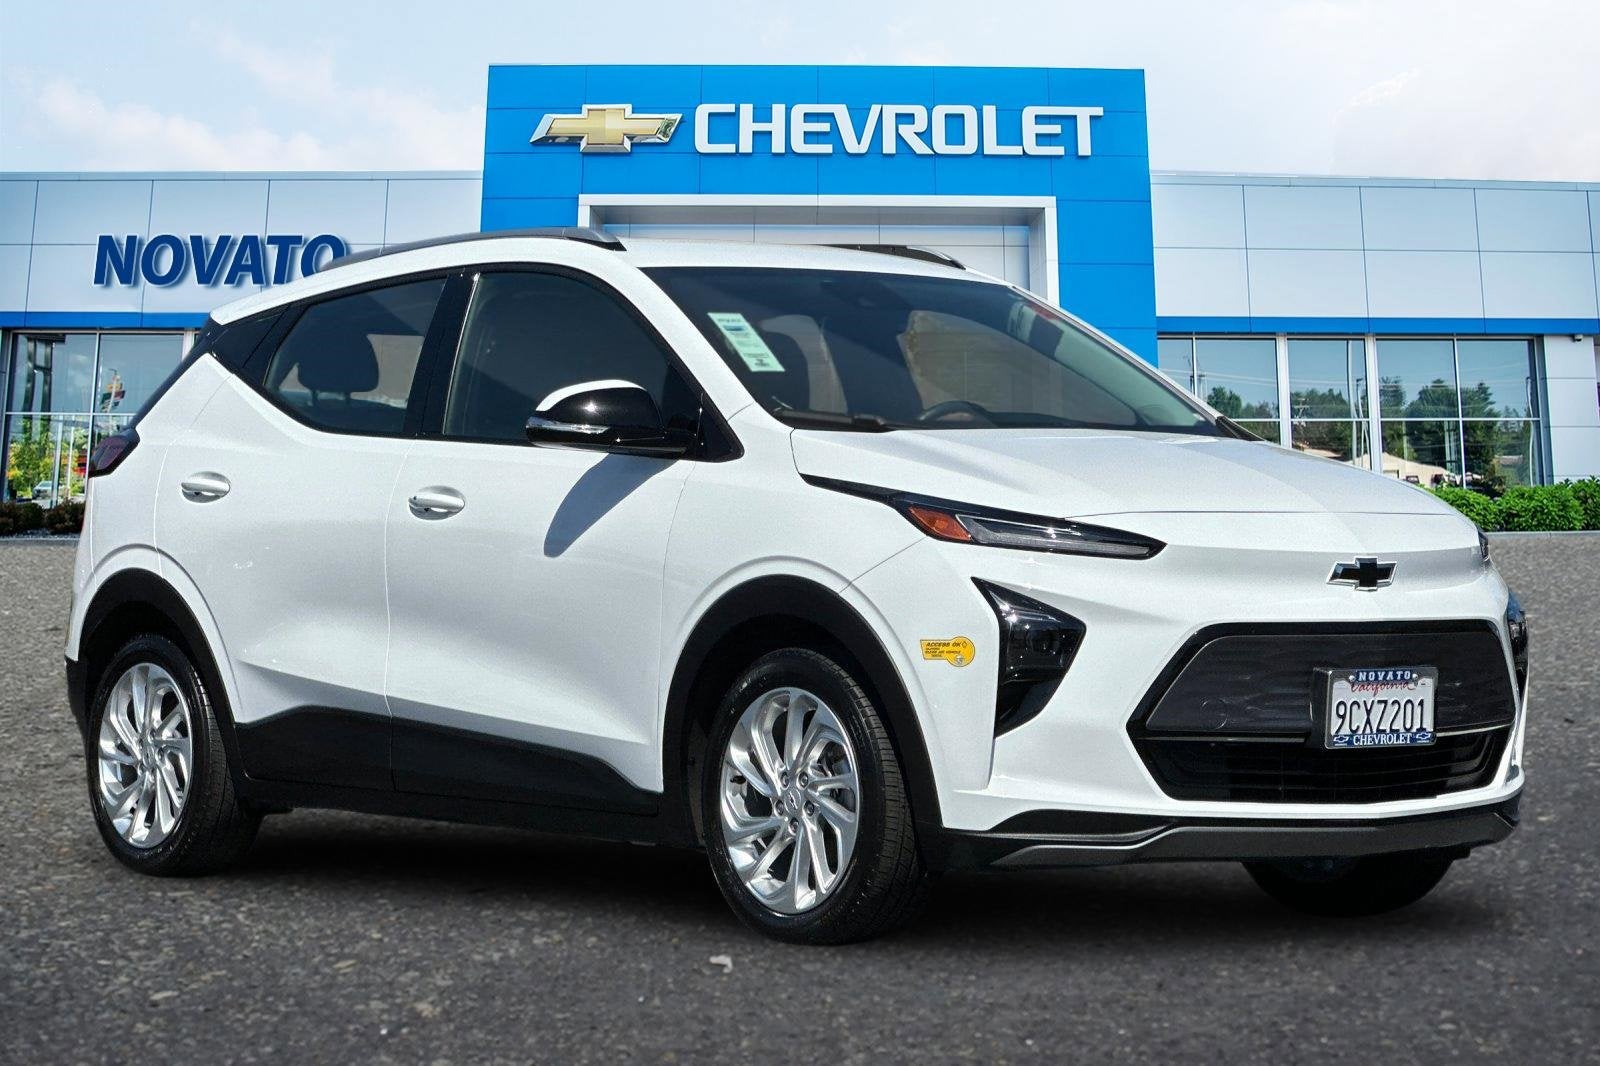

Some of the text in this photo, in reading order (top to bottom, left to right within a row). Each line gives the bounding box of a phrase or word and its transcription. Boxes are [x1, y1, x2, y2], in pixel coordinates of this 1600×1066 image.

[693, 103, 1104, 157] CHEVROLET
[94, 235, 347, 285] NOVATO
[1358, 671, 1410, 681] NOVATO
[1335, 699, 1426, 735] 9CXZ201
[1353, 734, 1412, 746] CHEVROLET
